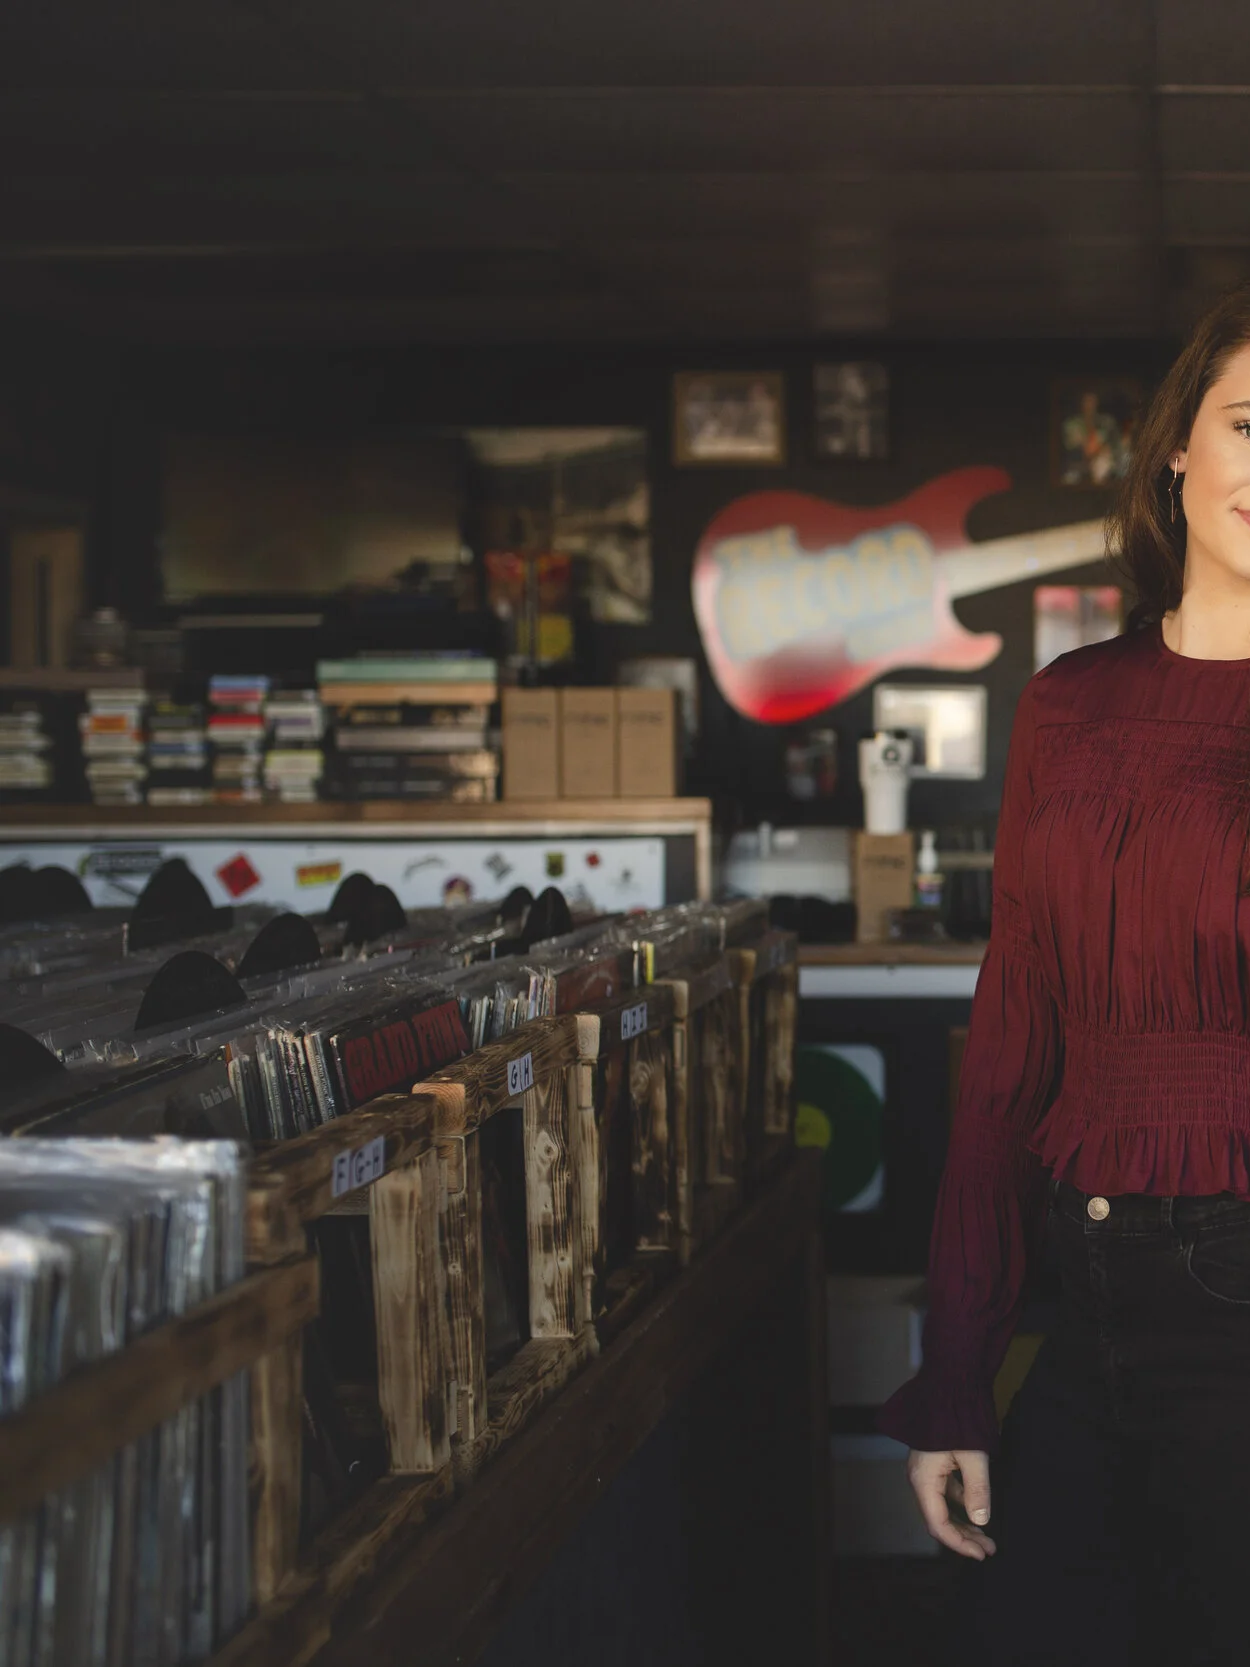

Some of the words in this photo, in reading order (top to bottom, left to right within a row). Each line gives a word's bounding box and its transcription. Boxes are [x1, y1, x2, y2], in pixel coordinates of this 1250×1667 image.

[720, 529, 933, 652] RECORD
[344, 1020, 419, 1101] GRAND
[411, 999, 471, 1068] FUNK
[336, 1157, 346, 1193] F
